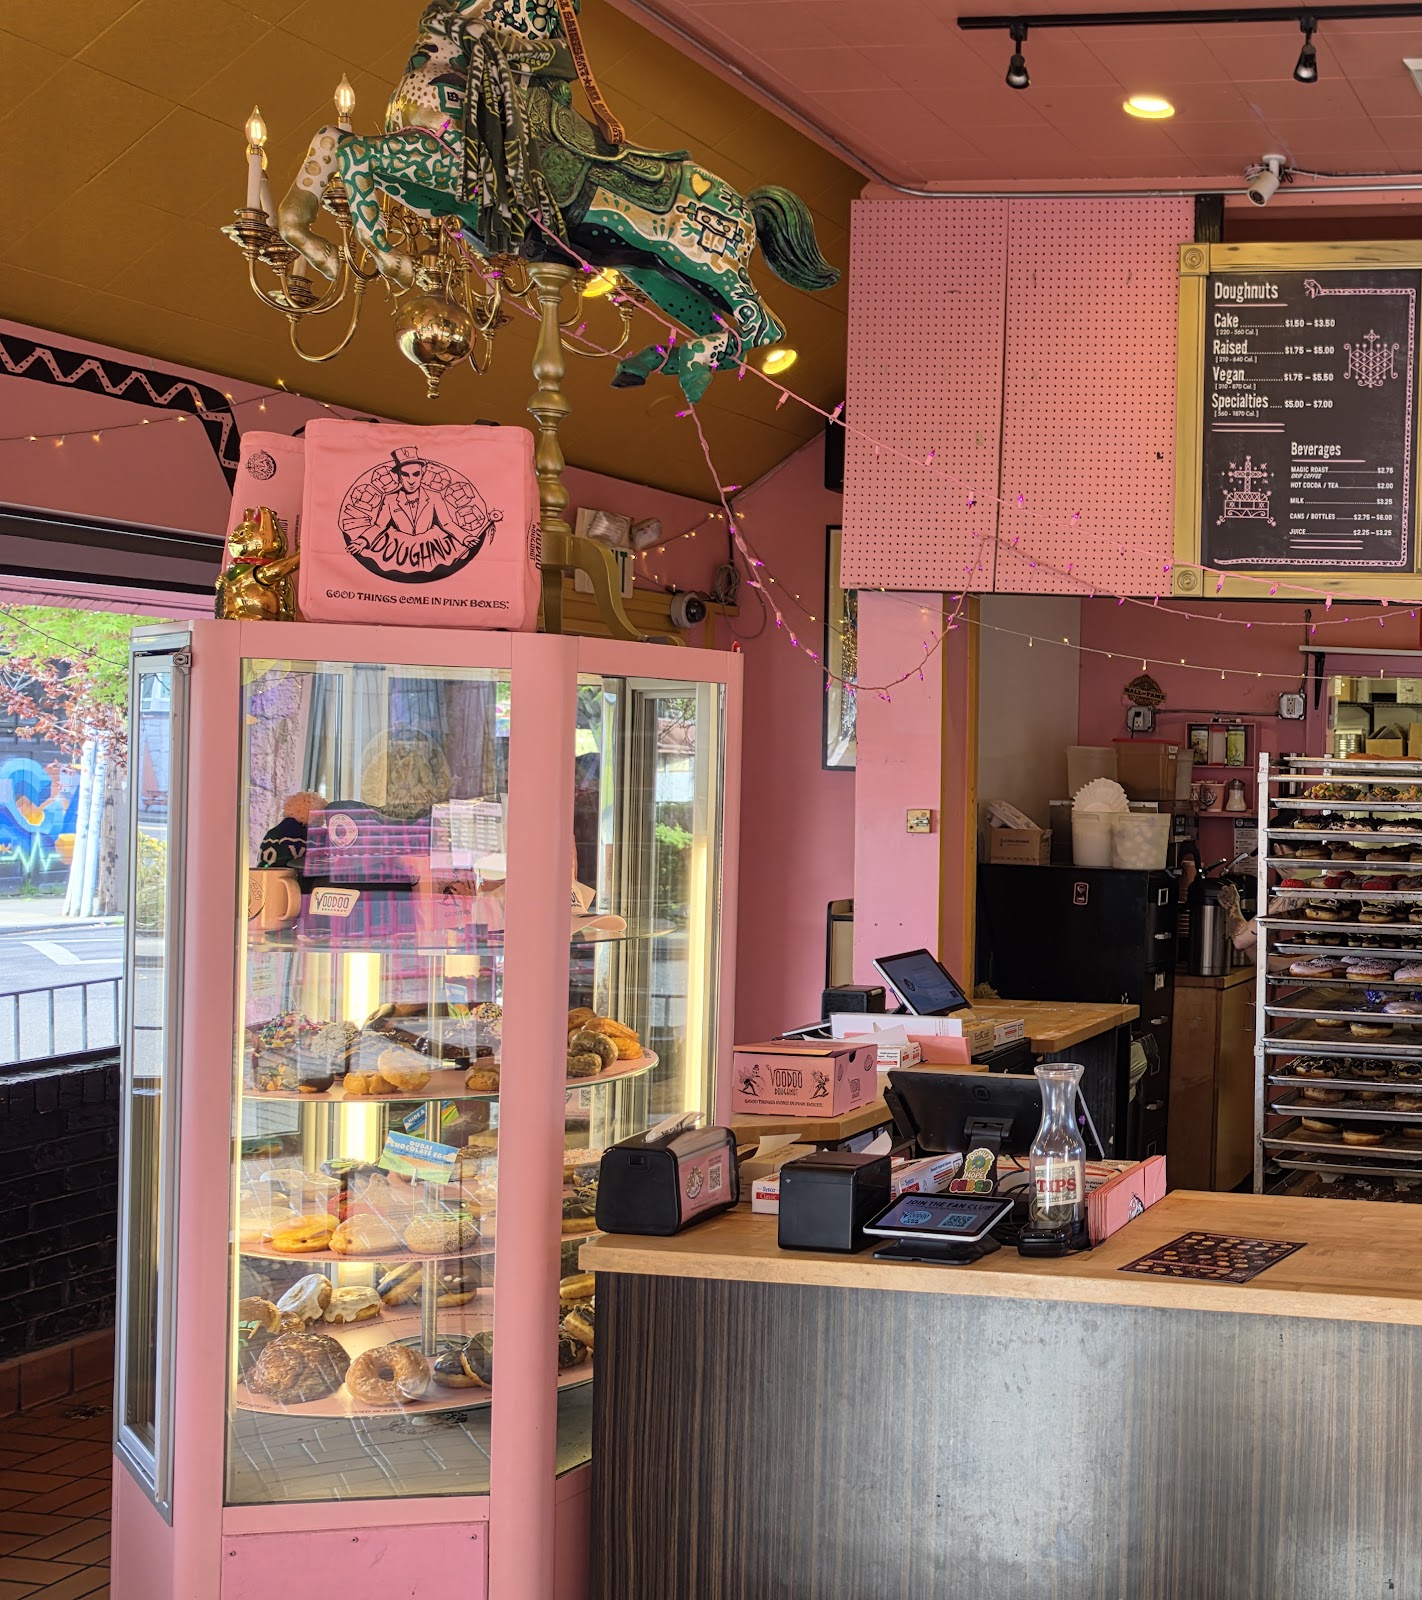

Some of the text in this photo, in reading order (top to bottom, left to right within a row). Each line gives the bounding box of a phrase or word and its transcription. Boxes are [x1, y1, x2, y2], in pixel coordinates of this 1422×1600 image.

[1215, 282, 1278, 302] Doughnuts
[1214, 313, 1239, 328] Cake
[1314, 319, 1335, 327] $3.50
[1213, 340, 1247, 354] Raised
[1314, 346, 1334, 354] $5.00
[1213, 367, 1244, 384] Vegan
[1212, 394, 1268, 410] Specialties
[1313, 400, 1333, 408] $7.00
[1291, 442, 1341, 458] Beverages
[342, 465, 485, 531] VOODOO
[371, 533, 459, 569] DOUGHNUT
[326, 589, 468, 608] GOOD THINGS COME IN PINK
[1146, 692, 1165, 700] FAME
[315, 892, 349, 911] VOODOO
[766, 1064, 803, 1088] VOODOO
[775, 1088, 798, 1096] DOUGHNUT
[390, 1142, 433, 1155] CHOCOLATE
[410, 1141, 432, 1150] DUBAI
[970, 1150, 992, 1160] DONUT
[1037, 1177, 1077, 1193] TIPS
